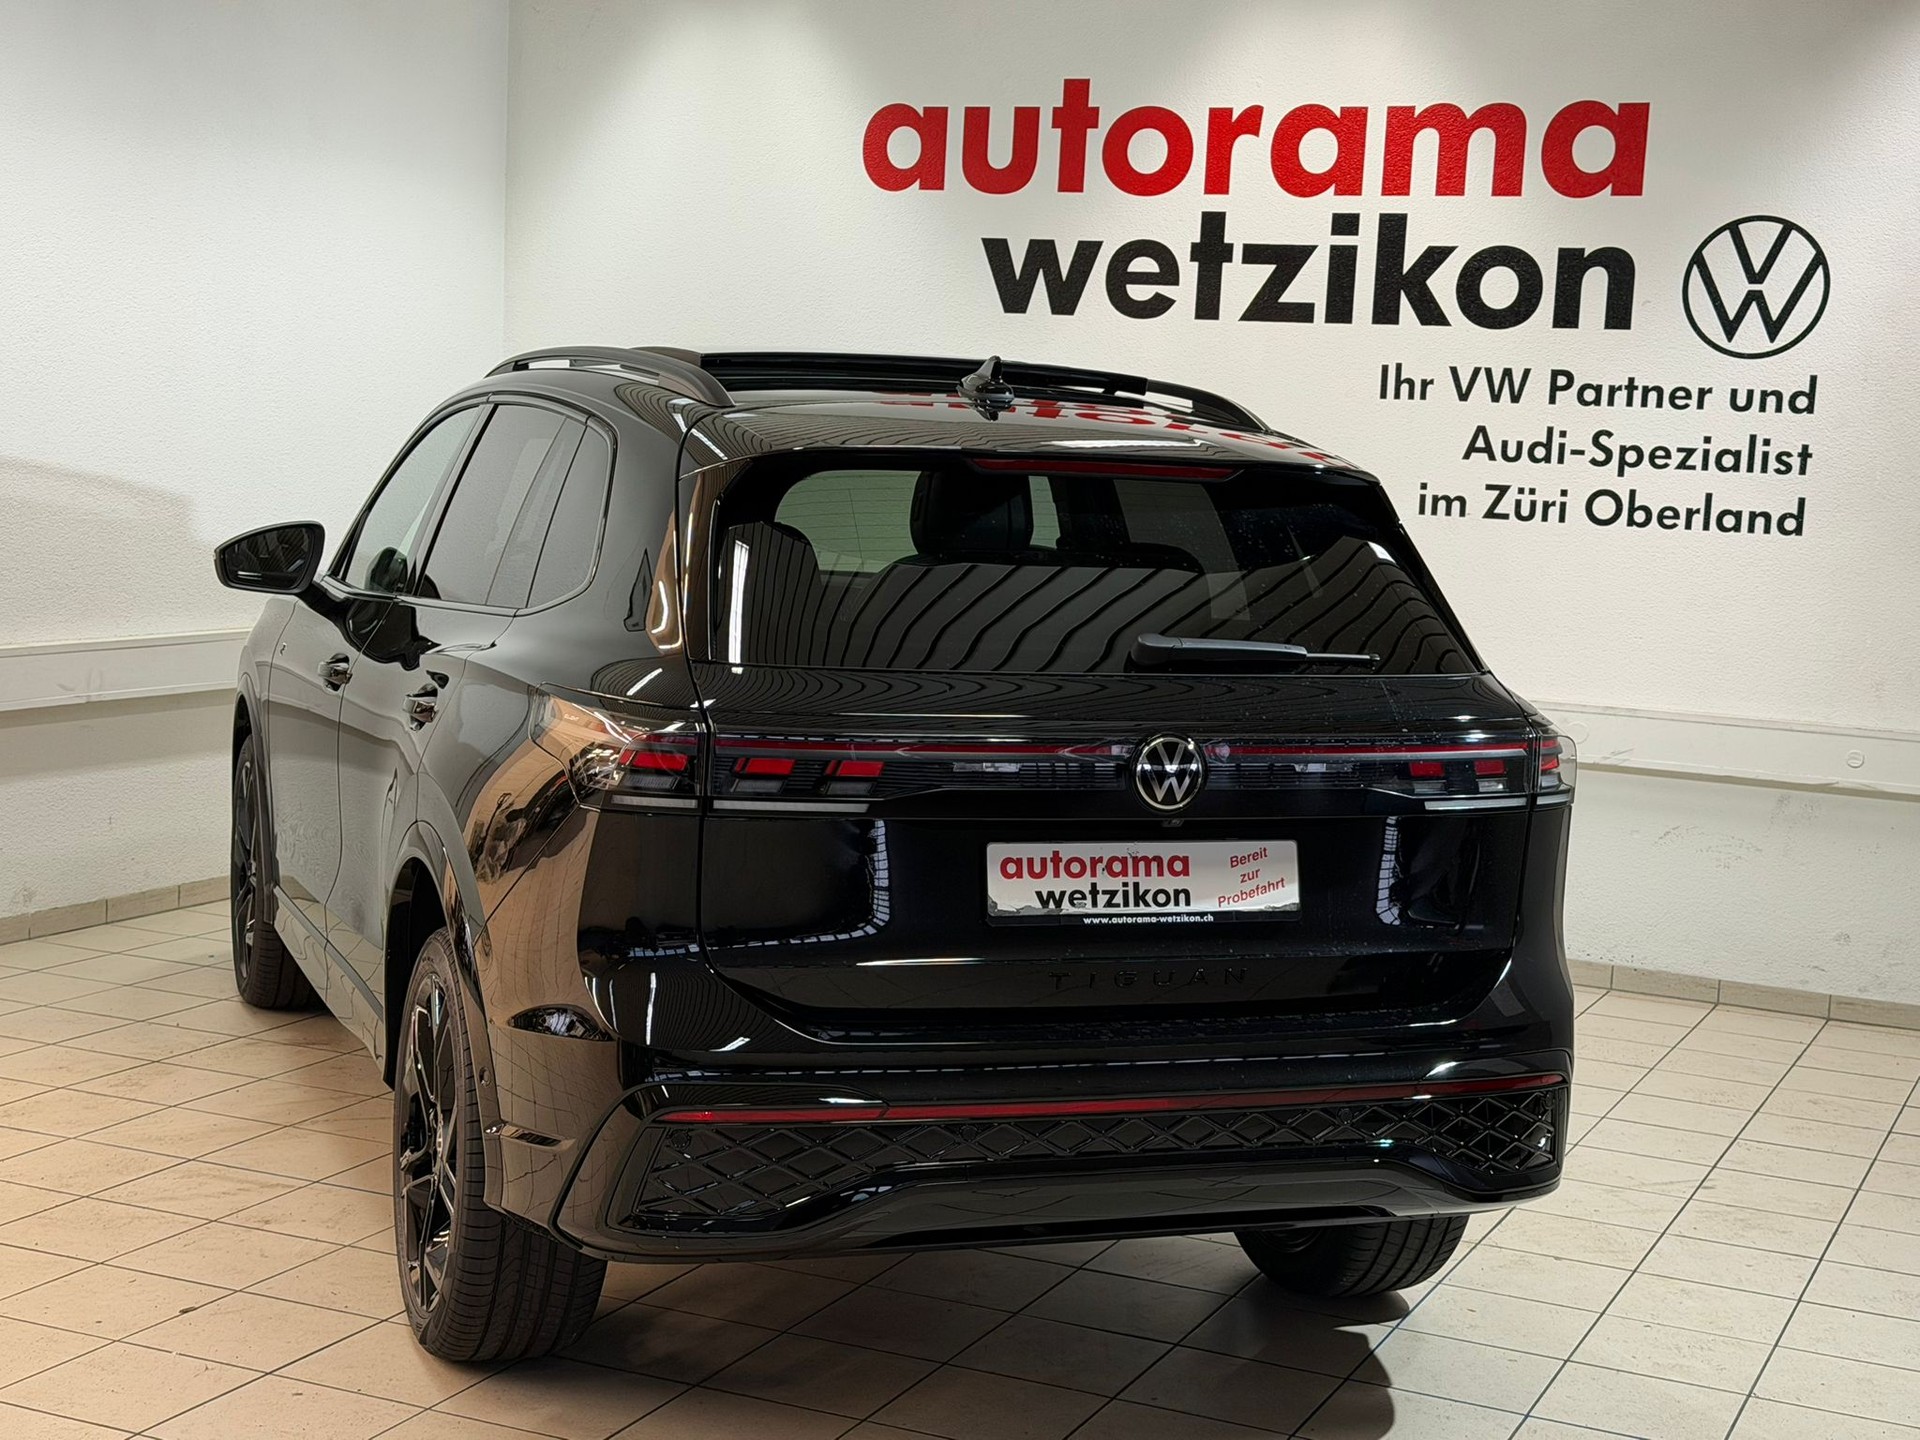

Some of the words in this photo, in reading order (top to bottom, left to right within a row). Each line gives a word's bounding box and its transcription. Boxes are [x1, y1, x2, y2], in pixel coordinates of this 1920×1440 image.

[863, 79, 1650, 198] autorama
[981, 212, 1635, 330] wetzikon
[1379, 362, 1434, 401] Ihr
[1449, 366, 1532, 404] VW
[1548, 369, 1713, 411] Partner
[1727, 376, 1818, 415] und
[1462, 425, 1813, 479] Audi-Spezialist
[1418, 482, 1467, 518] im
[1482, 483, 1568, 524] Züri
[1585, 488, 1806, 537] Oberland
[1000, 850, 1190, 880] autorama
[1230, 847, 1268, 868] Bereit
[1240, 868, 1261, 883] zur
[1035, 881, 1191, 909] wetzikon
[1217, 877, 1286, 908] Probefahrt
[1083, 913, 1214, 924] www.autorama-wetzikon.ch
[1049, 968, 1248, 990] TIGUAN
